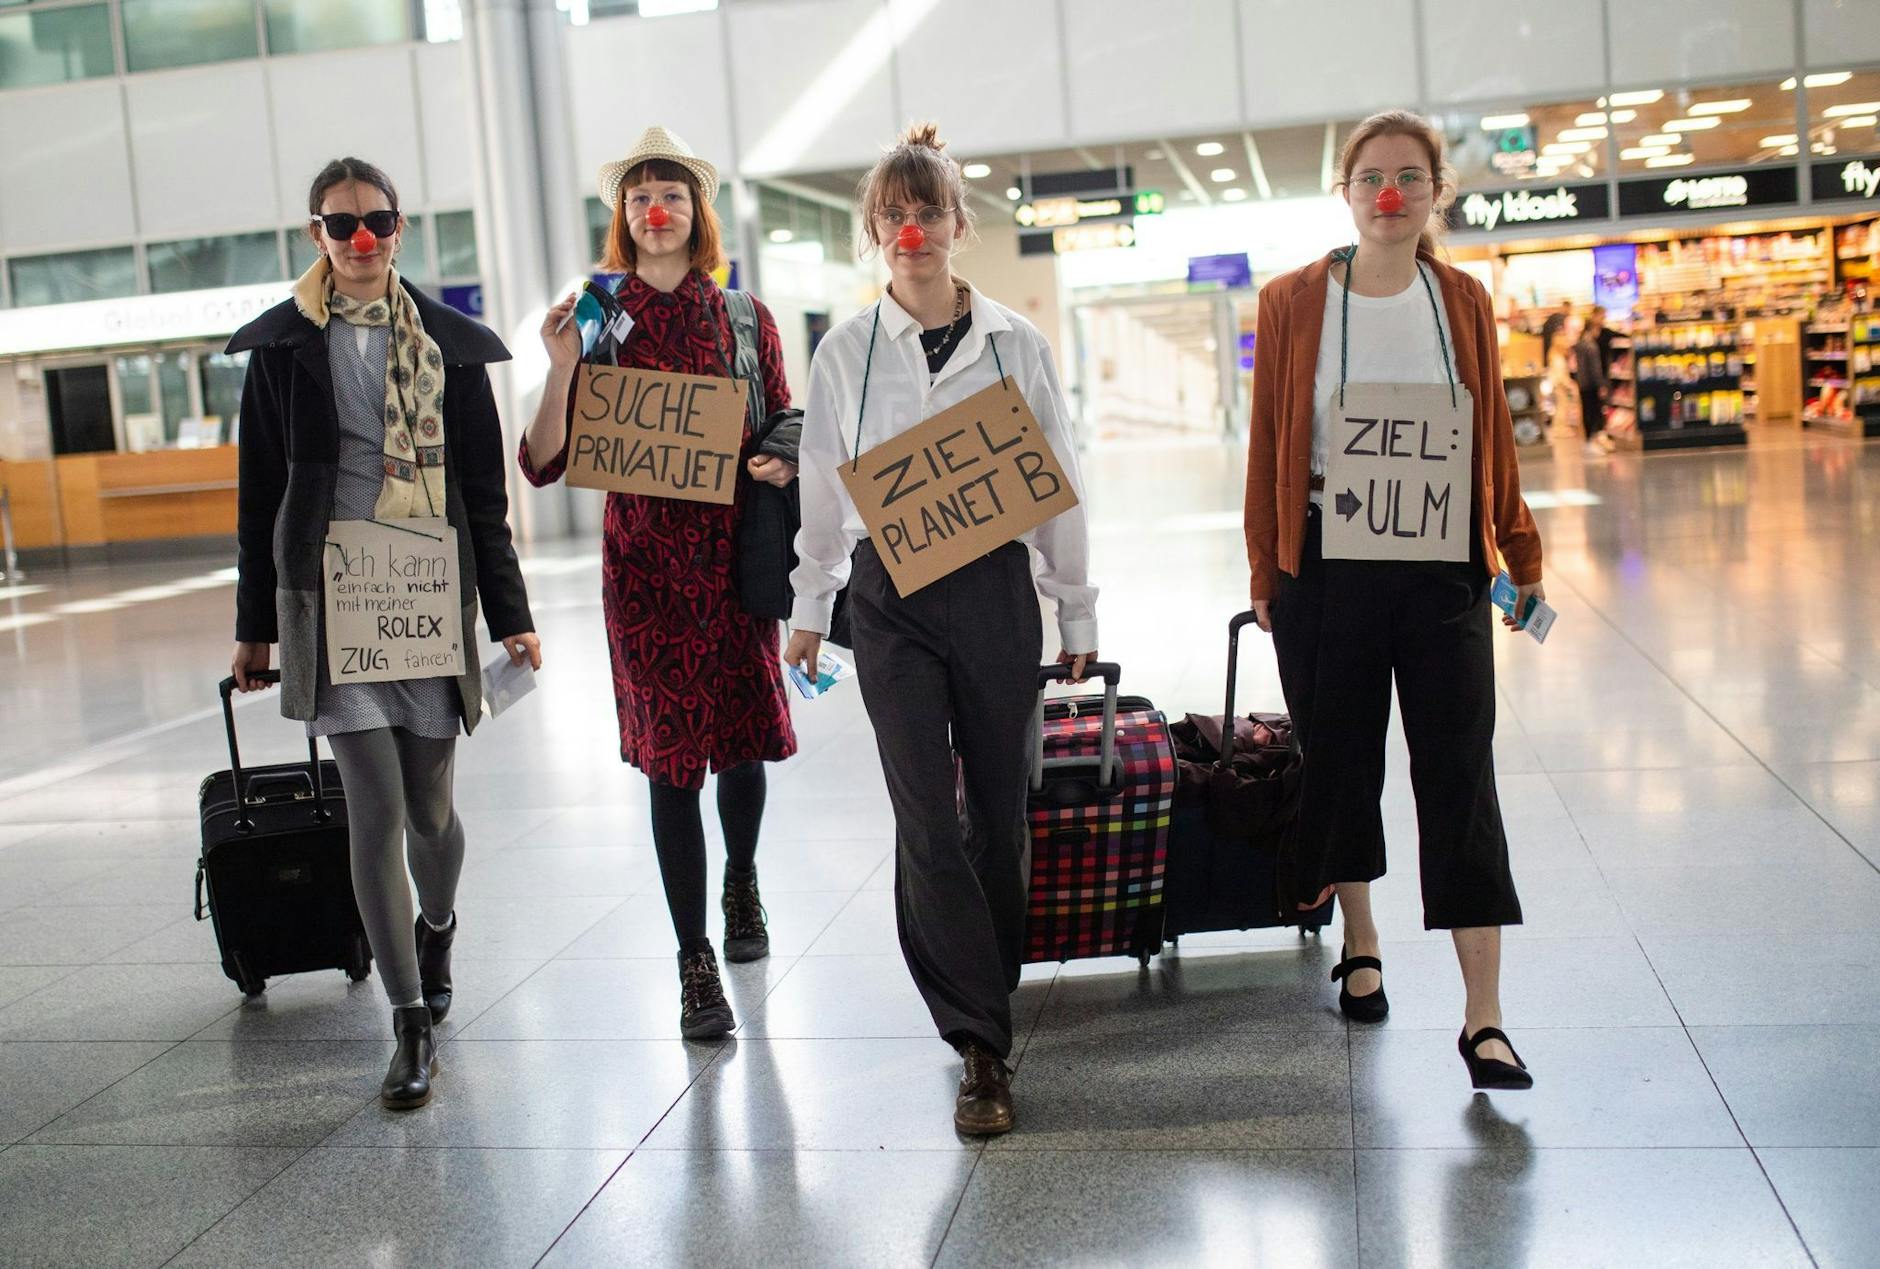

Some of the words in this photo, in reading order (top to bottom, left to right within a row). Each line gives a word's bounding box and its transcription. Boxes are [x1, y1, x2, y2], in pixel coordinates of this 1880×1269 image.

[1462, 193, 1502, 231] fly
[1503, 186, 1578, 222] kiosk
[580, 372, 717, 438] SUCHE
[872, 406, 1028, 508] ZIEL:
[1344, 417, 1459, 461] ZIEL:
[573, 434, 734, 491] PRIVATJET
[881, 468, 1005, 565] PLANET
[1014, 451, 1060, 502] B
[1367, 479, 1450, 540] ULM
[388, 543, 447, 578] kann
[336, 597, 361, 612] mit
[365, 597, 416, 612] meiner
[337, 581, 395, 594] einfach
[407, 579, 450, 593] nicht
[377, 615, 443, 640] ROLEX
[341, 647, 389, 675] ZUG
